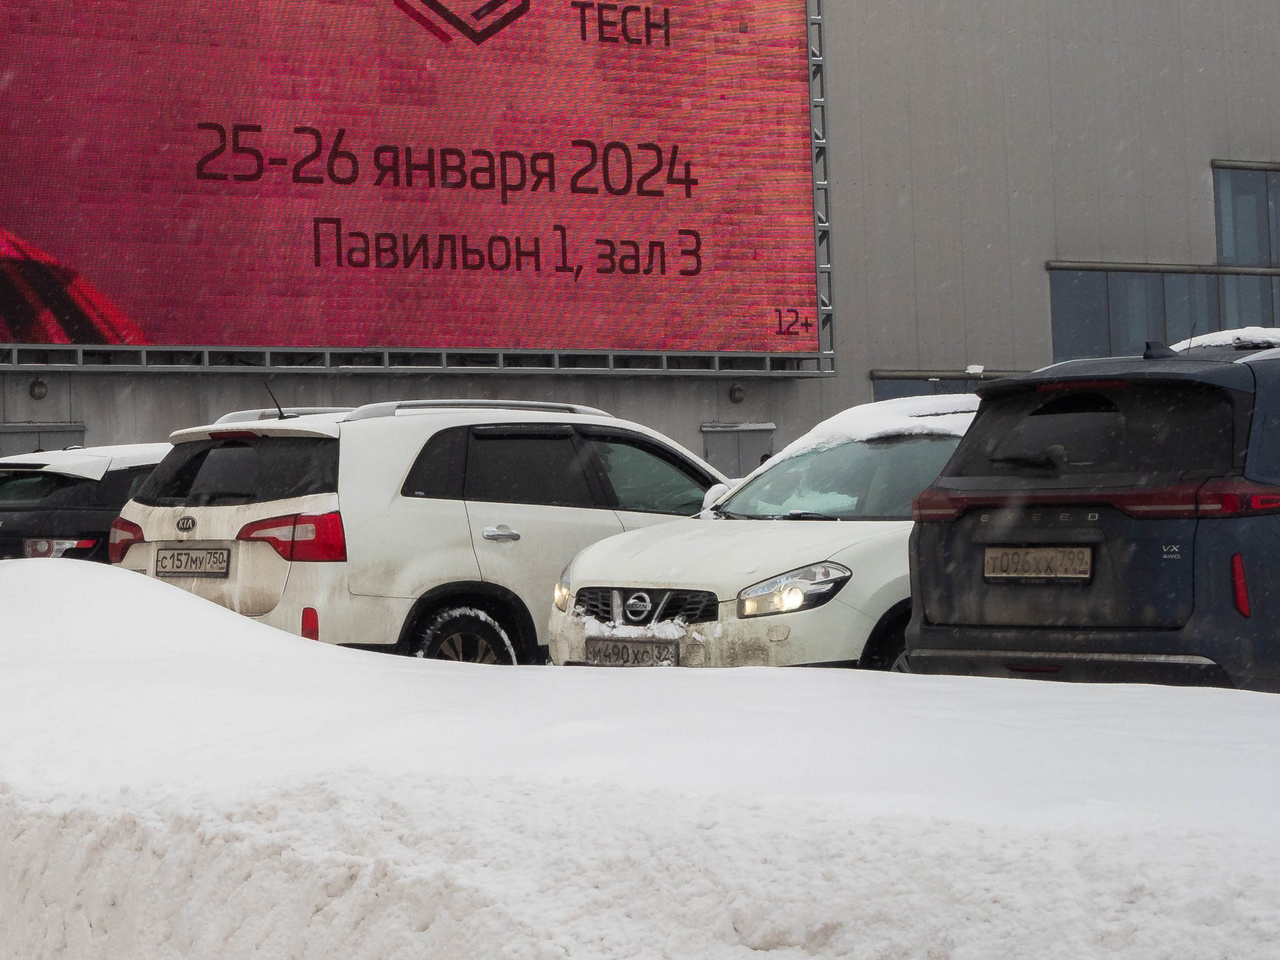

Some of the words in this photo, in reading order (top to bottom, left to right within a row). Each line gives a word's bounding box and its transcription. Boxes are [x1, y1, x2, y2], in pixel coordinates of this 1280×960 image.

[570, 0, 671, 47] TECH
[195, 121, 360, 186] 25-26
[372, 143, 556, 205] января
[569, 139, 700, 199] 2024
[312, 217, 542, 273] Павильон
[553, 224, 585, 283] 1,
[596, 237, 667, 277] зал
[678, 228, 703, 277] 3
[774, 308, 813, 336] 12+
[178, 520, 193, 529] KIA
[980, 513, 1099, 522] EXEED
[1162, 544, 1180, 552] VX
